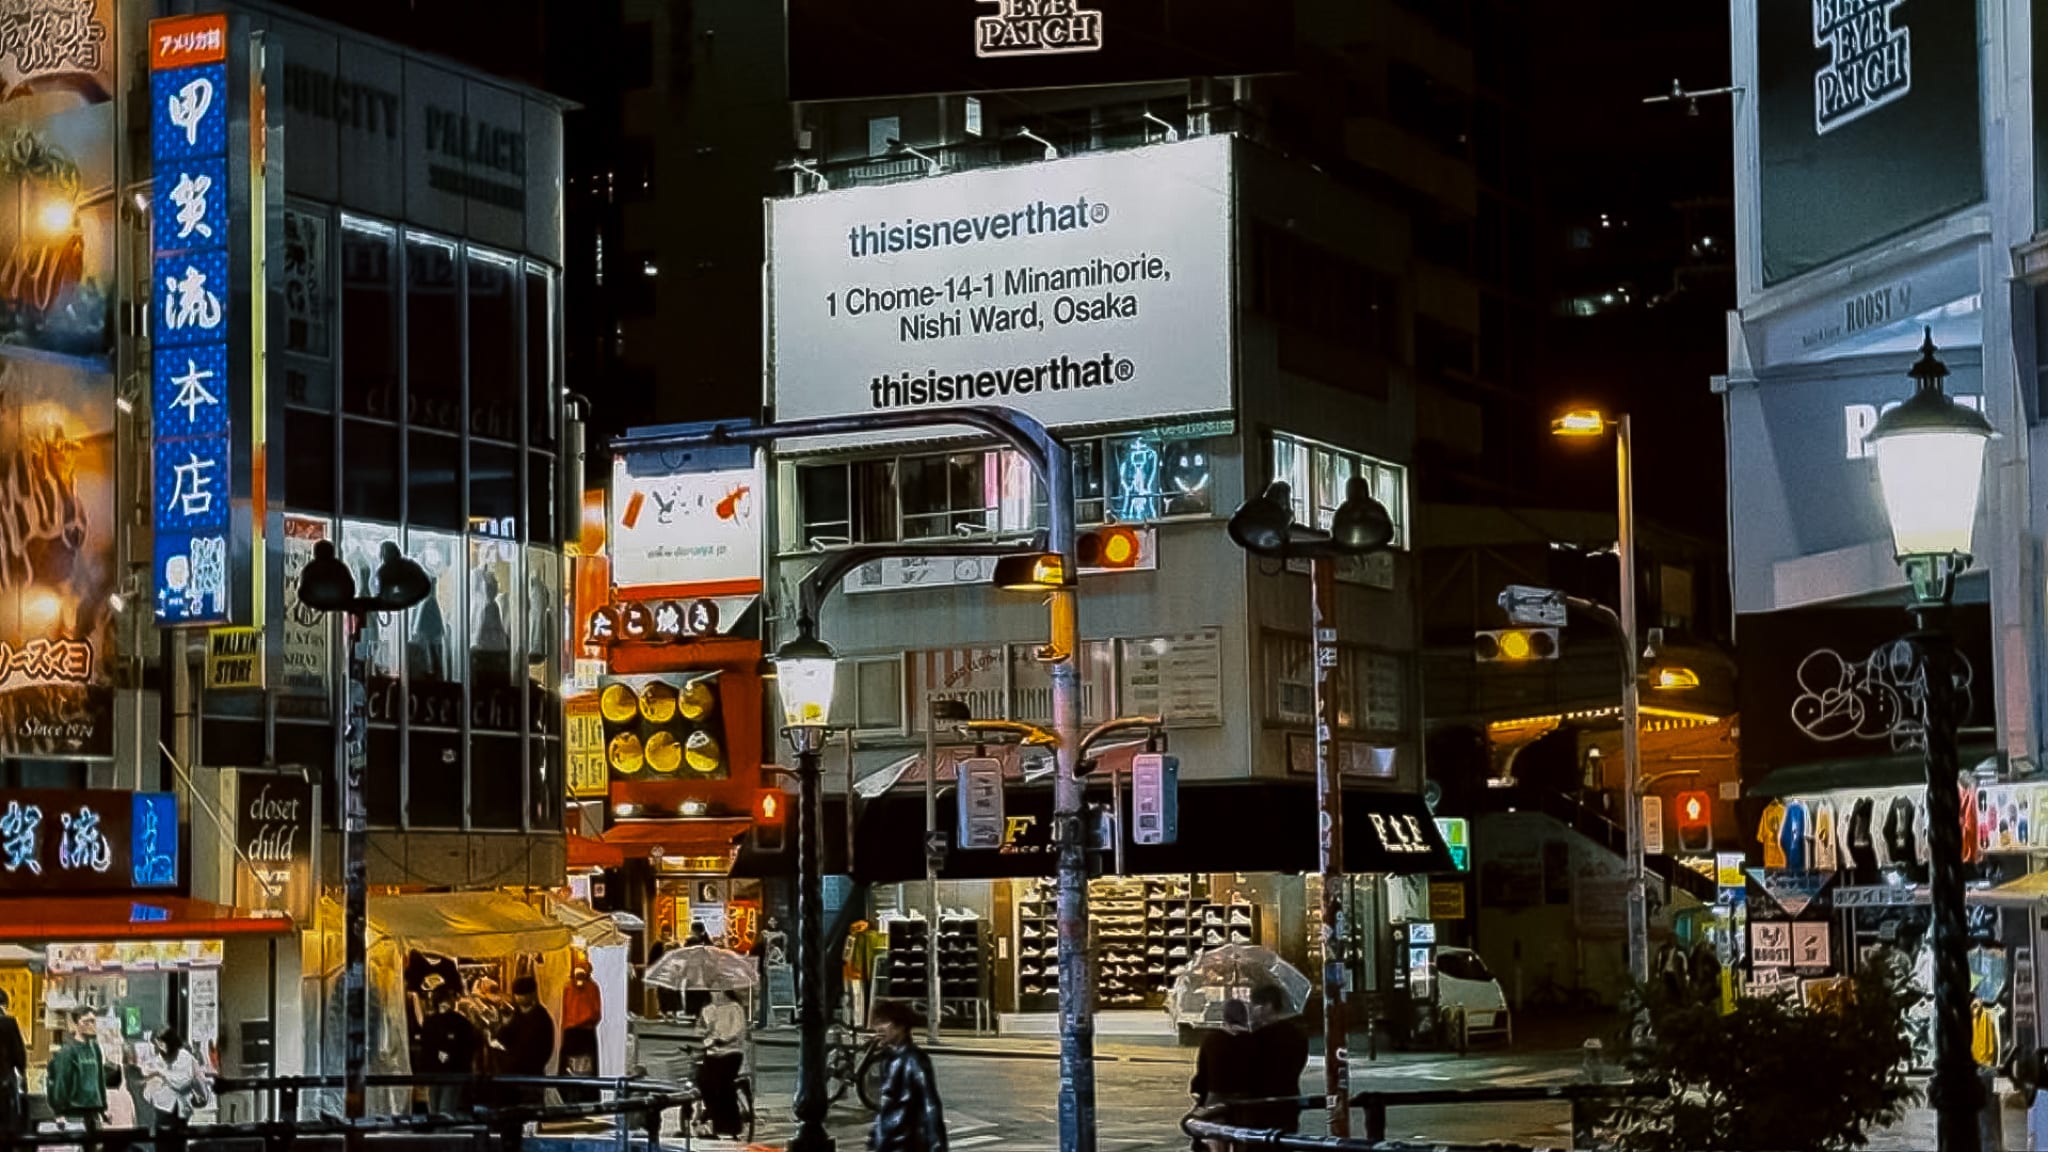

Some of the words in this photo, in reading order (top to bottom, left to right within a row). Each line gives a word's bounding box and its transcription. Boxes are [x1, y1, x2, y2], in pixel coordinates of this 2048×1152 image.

[159, 26, 221, 56] アメリカ村
[983, 16, 1091, 47] PATCH
[1836, 4, 1883, 64] EYE
[1821, 39, 1901, 118] PATCH
[165, 77, 221, 515] 甲賀流本店
[826, 292, 837, 317] 1
[845, 271, 995, 316] Chome-14-1
[1004, 253, 1171, 296] Minamihorie,
[900, 309, 961, 342] Nishi
[970, 300, 1045, 335] Ward,
[1053, 292, 1138, 325] Osaka
[870, 352, 1134, 409] thisisneverthat®
[250, 783, 300, 821] closet
[248, 823, 300, 861] child
